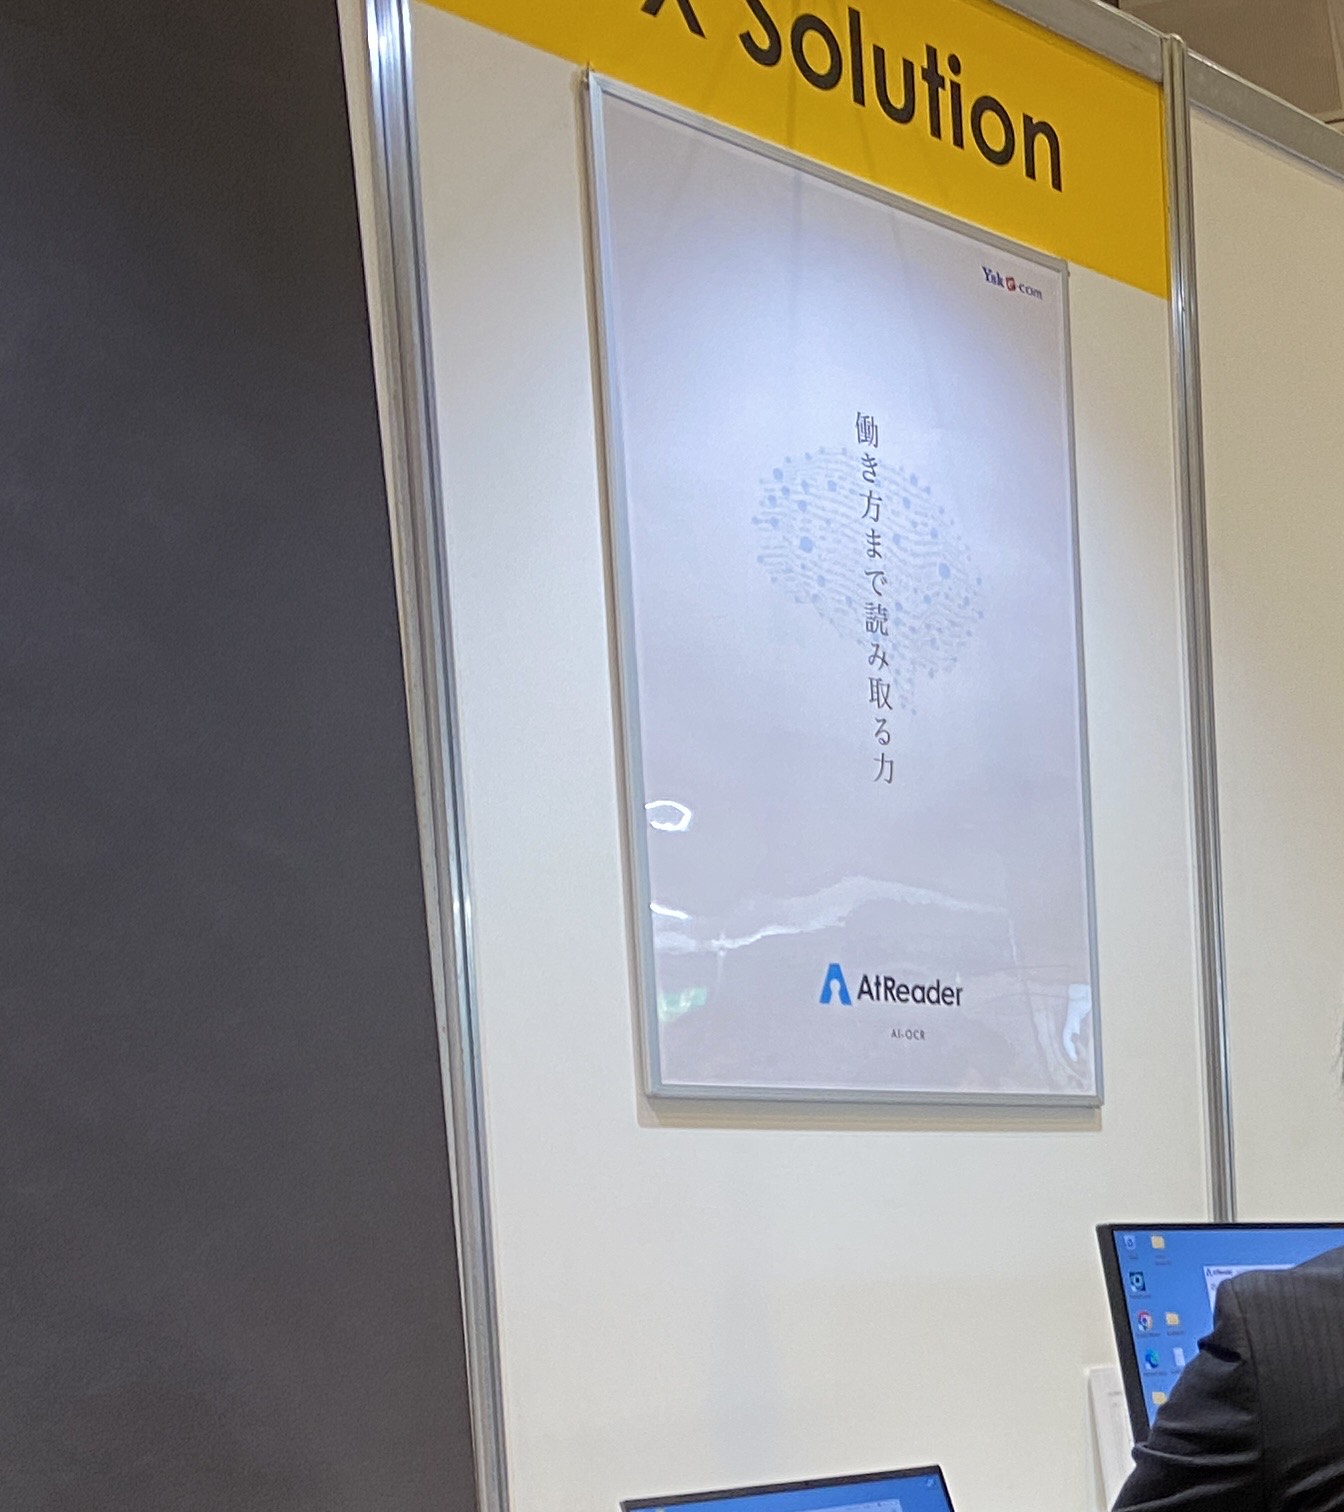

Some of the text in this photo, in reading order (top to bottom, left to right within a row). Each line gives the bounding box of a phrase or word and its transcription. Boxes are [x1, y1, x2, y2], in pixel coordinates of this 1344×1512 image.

[740, 0, 1062, 193] Solution
[855, 411, 894, 785] 働き方まで読み取る力
[857, 973, 963, 1006] AtReader
[891, 1028, 926, 1041] AI-OCR
